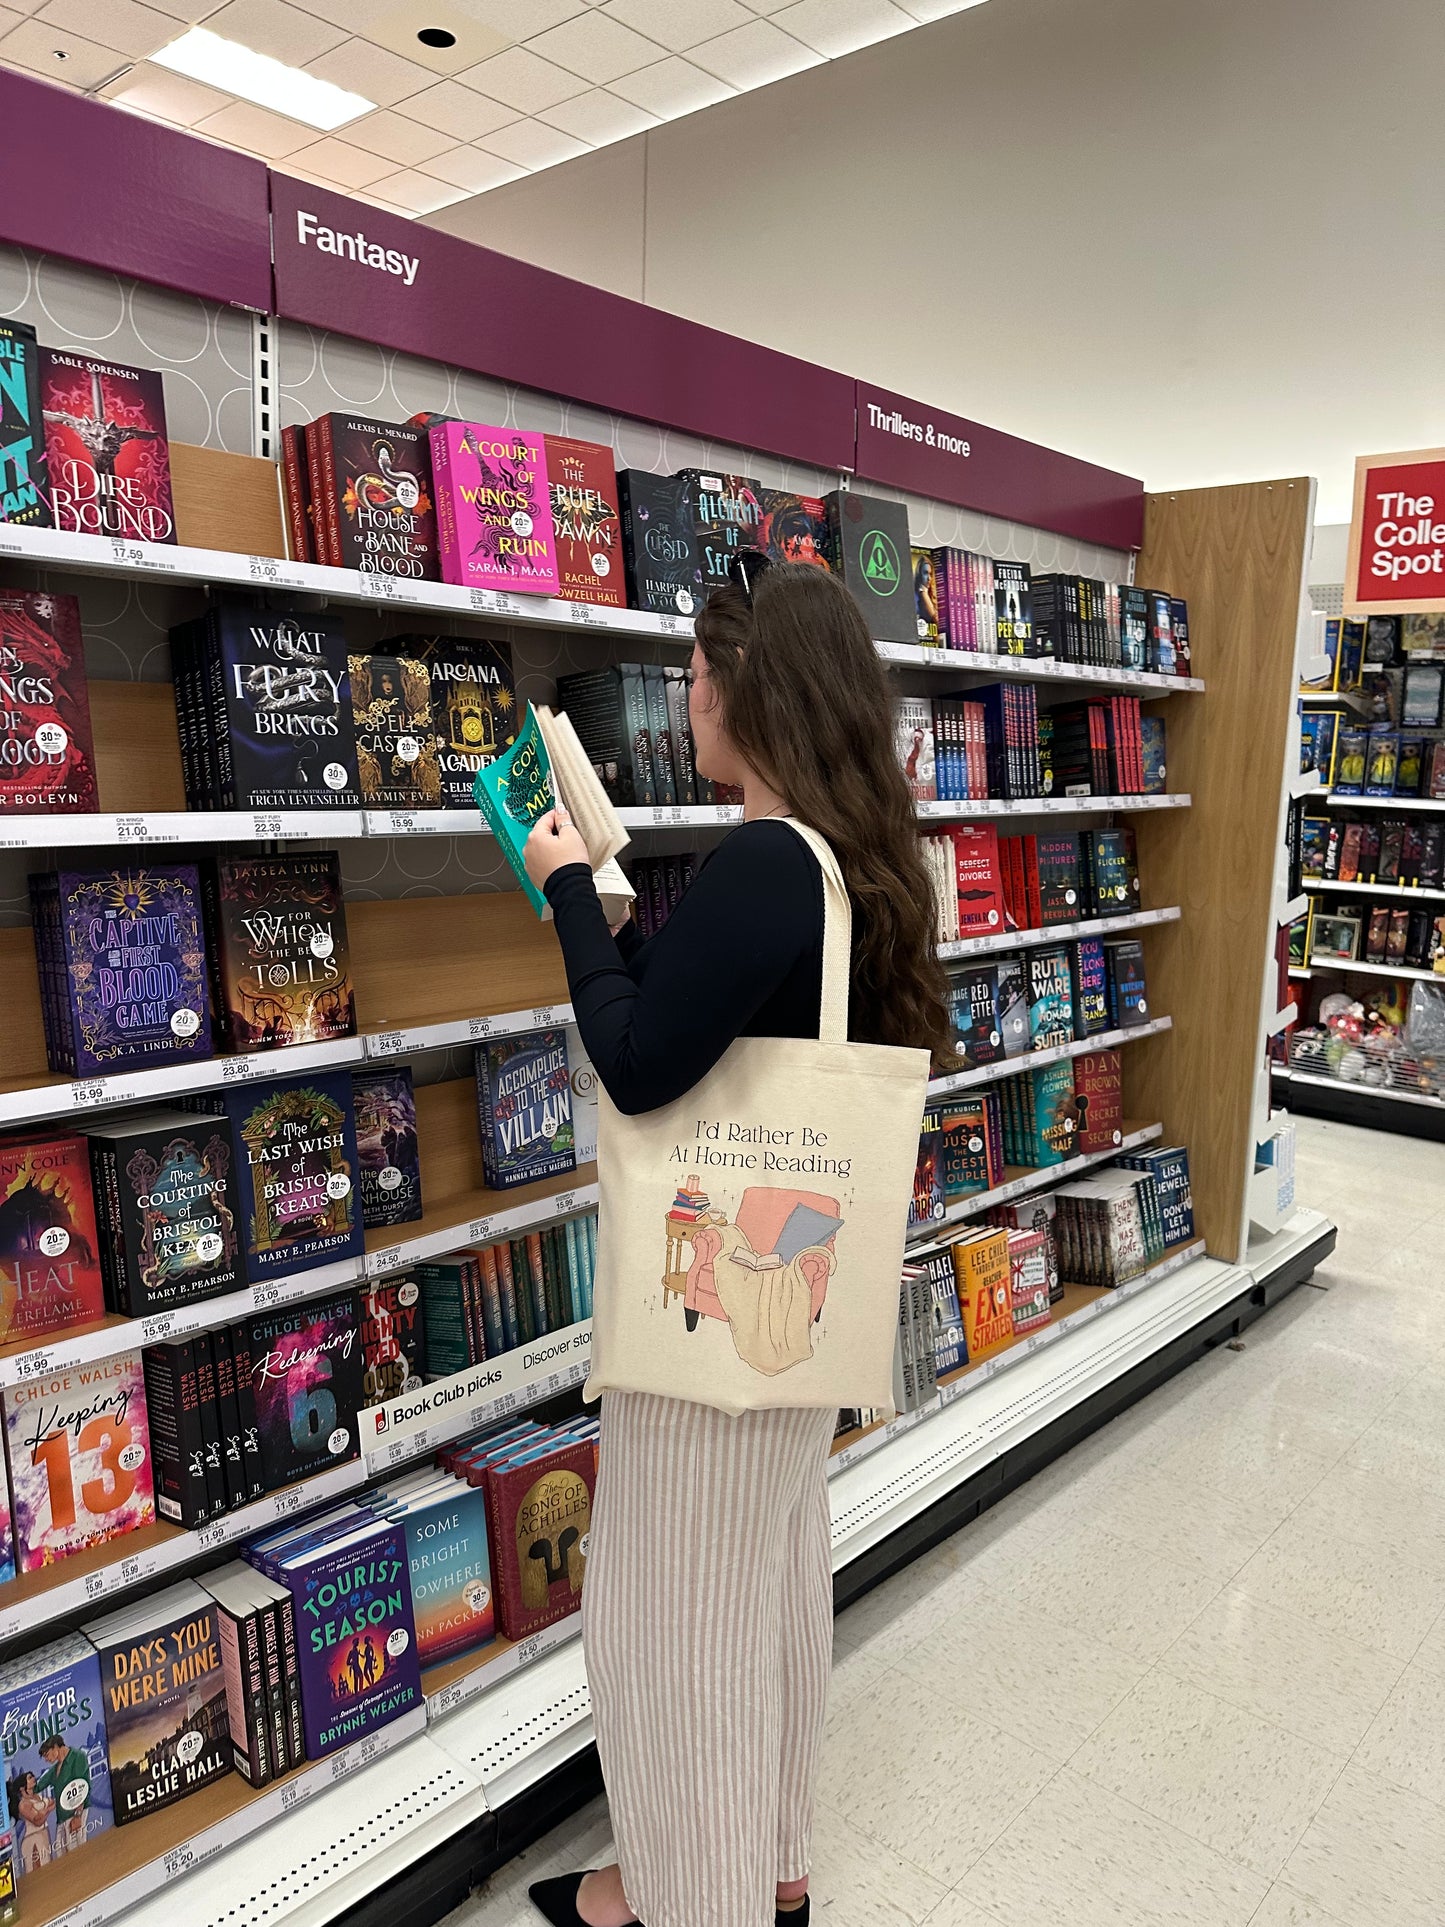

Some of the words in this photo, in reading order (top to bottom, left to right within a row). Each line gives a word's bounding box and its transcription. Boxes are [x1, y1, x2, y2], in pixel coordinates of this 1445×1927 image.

[297, 210, 419, 285] Fantasy
[51, 354, 83, 368] SABLE
[87, 362, 139, 380] SORENSEN
[347, 422, 375, 434] ALEXIS
[385, 429, 417, 441] MENARD
[868, 403, 923, 442] Thrillers
[926, 424, 936, 447] &
[938, 433, 970, 457] more
[459, 443, 471, 454] A
[478, 441, 539, 462] COURT
[518, 471, 536, 483] OF
[564, 468, 584, 482] THE
[459, 486, 528, 509] WINGS
[1377, 492, 1434, 518] The
[357, 508, 420, 534] HOUSE
[484, 516, 511, 526] AND
[726, 528, 738, 546] OF
[113, 548, 142, 559] 17.59
[499, 537, 547, 557] RUIN
[250, 566, 277, 576] 21.00
[468, 562, 507, 575] SARAH
[521, 567, 553, 577] MAAS
[999, 569, 1022, 579] FREIDA
[1371, 549, 1444, 581] Spot
[369, 582, 392, 593] 15.19
[565, 573, 602, 586] RACHEL
[597, 589, 619, 604] HALL
[1008, 640, 1024, 654] SON
[432, 662, 501, 684] ARCANA
[255, 713, 339, 736] BRINGS
[15, 794, 78, 804] BOLEYN
[247, 795, 285, 806] TRICIA
[363, 791, 409, 802] JAYMIN
[411, 791, 433, 801] EVE
[118, 827, 147, 836] 21.00
[255, 823, 280, 832] 22.39
[392, 820, 413, 828] 15.99
[960, 859, 990, 869] PERFECT
[1098, 858, 1126, 866] FLICKER
[234, 866, 288, 880] JAYSEA
[295, 864, 329, 874] LYNN
[960, 872, 992, 881] DIVORCE
[288, 912, 312, 921] FOR
[960, 913, 981, 924] JENEVA
[89, 913, 182, 952] CAPTIVE
[121, 945, 161, 969] FIRST
[268, 949, 291, 958] THE
[1081, 942, 1098, 954] YOU
[250, 957, 339, 989] TOLLS
[1031, 957, 1069, 980] RUTH
[100, 962, 179, 1008] BLOOD
[971, 985, 989, 1001] RED
[1031, 977, 1070, 999] WARE
[116, 1002, 169, 1028] GAME
[533, 1013, 551, 1023] 17.59
[470, 1024, 490, 1034] 22.40
[144, 1041, 174, 1052] LINDE
[379, 1039, 402, 1049] 24.50
[1034, 1032, 1064, 1050] SUITE
[222, 1065, 249, 1076] 23.80
[498, 1047, 566, 1099] ACCOMPLICE
[1085, 1057, 1120, 1074] DAN
[1042, 1079, 1071, 1094] FLOWERS
[1085, 1074, 1120, 1092] BROWN
[73, 1089, 103, 1101] 15.99
[515, 1093, 528, 1110] TO
[531, 1078, 549, 1099] THE
[954, 1105, 981, 1113] KUBICA
[1089, 1106, 1120, 1121] SECRET
[283, 1123, 308, 1141] The
[696, 1120, 720, 1140] I'd
[728, 1123, 794, 1145] Rather
[802, 1128, 828, 1147] Be
[248, 1144, 292, 1165] LAST
[298, 1133, 344, 1154] WISH
[1051, 1138, 1073, 1154] HALF
[31, 1154, 70, 1171] COLE
[292, 1157, 306, 1175] of
[669, 1145, 688, 1163] At
[696, 1146, 757, 1169] Home
[764, 1152, 852, 1178] Reading
[170, 1170, 194, 1188] The
[505, 1171, 528, 1184] HANNAH
[1162, 1164, 1182, 1179] LISA
[136, 1179, 228, 1209] COURTING
[1157, 1176, 1189, 1194] JEWELL
[178, 1203, 192, 1219] of
[274, 1192, 330, 1217] KEATS
[556, 1199, 573, 1209] 15.99
[1113, 1199, 1133, 1215] THEN
[153, 1215, 222, 1242] BRISTOL
[1117, 1213, 1131, 1226] SHE
[1169, 1214, 1184, 1227] LET
[470, 1225, 489, 1237] 23.09
[1118, 1229, 1134, 1241] WAS
[1165, 1228, 1180, 1242] HIM
[1181, 1225, 1190, 1234] IN
[258, 1251, 289, 1264] MARY
[305, 1233, 351, 1252] PEARSON
[971, 1250, 986, 1267] LEE
[989, 1240, 1007, 1259] CHILD
[1118, 1239, 1137, 1258] GONE
[376, 1255, 398, 1267] 24.50
[147, 1287, 176, 1301] MARY
[191, 1272, 236, 1290] PEARSON
[254, 1290, 279, 1304] 23.09
[143, 1323, 170, 1337] 15.99
[253, 1320, 301, 1341] CHLOE
[308, 1304, 353, 1326] WALSH
[251, 1328, 357, 1391] Redeeming
[523, 1342, 572, 1370] Discover
[16, 1360, 48, 1375] 15.99
[916, 1359, 924, 1391] FLINCH
[925, 1352, 933, 1384] FLINCH
[14, 1378, 73, 1404] CHLOE
[79, 1360, 134, 1385] WALSH
[903, 1365, 912, 1398] FLINCH
[393, 1399, 431, 1425] Book
[433, 1386, 467, 1407] Club
[467, 1369, 502, 1398] picks
[31, 1414, 138, 1531] 13
[275, 1497, 299, 1512] 11.99
[521, 1495, 560, 1521] SONG
[564, 1482, 583, 1501] OF
[518, 1496, 589, 1539] ACHILLES
[199, 1528, 224, 1545] 11.99
[416, 1514, 460, 1541] SOME
[411, 1538, 470, 1573] BRIGHT
[121, 1564, 139, 1578] 15.99
[85, 1580, 103, 1594] 15.99
[303, 1560, 402, 1621] TOURIST
[310, 1589, 402, 1654] SEASON
[113, 1639, 167, 1681] DAYS
[171, 1615, 211, 1649] YOU
[110, 1666, 168, 1712] WERE
[171, 1643, 220, 1686] MINE
[48, 1687, 76, 1714] FOR
[319, 1714, 367, 1746] BRYNNE
[370, 1687, 415, 1719] WEAVER
[126, 1774, 180, 1811] LESLIE
[185, 1752, 224, 1783] HALL
[32, 1816, 104, 1862] SINGLETON
[165, 1851, 194, 1873] 15.20
